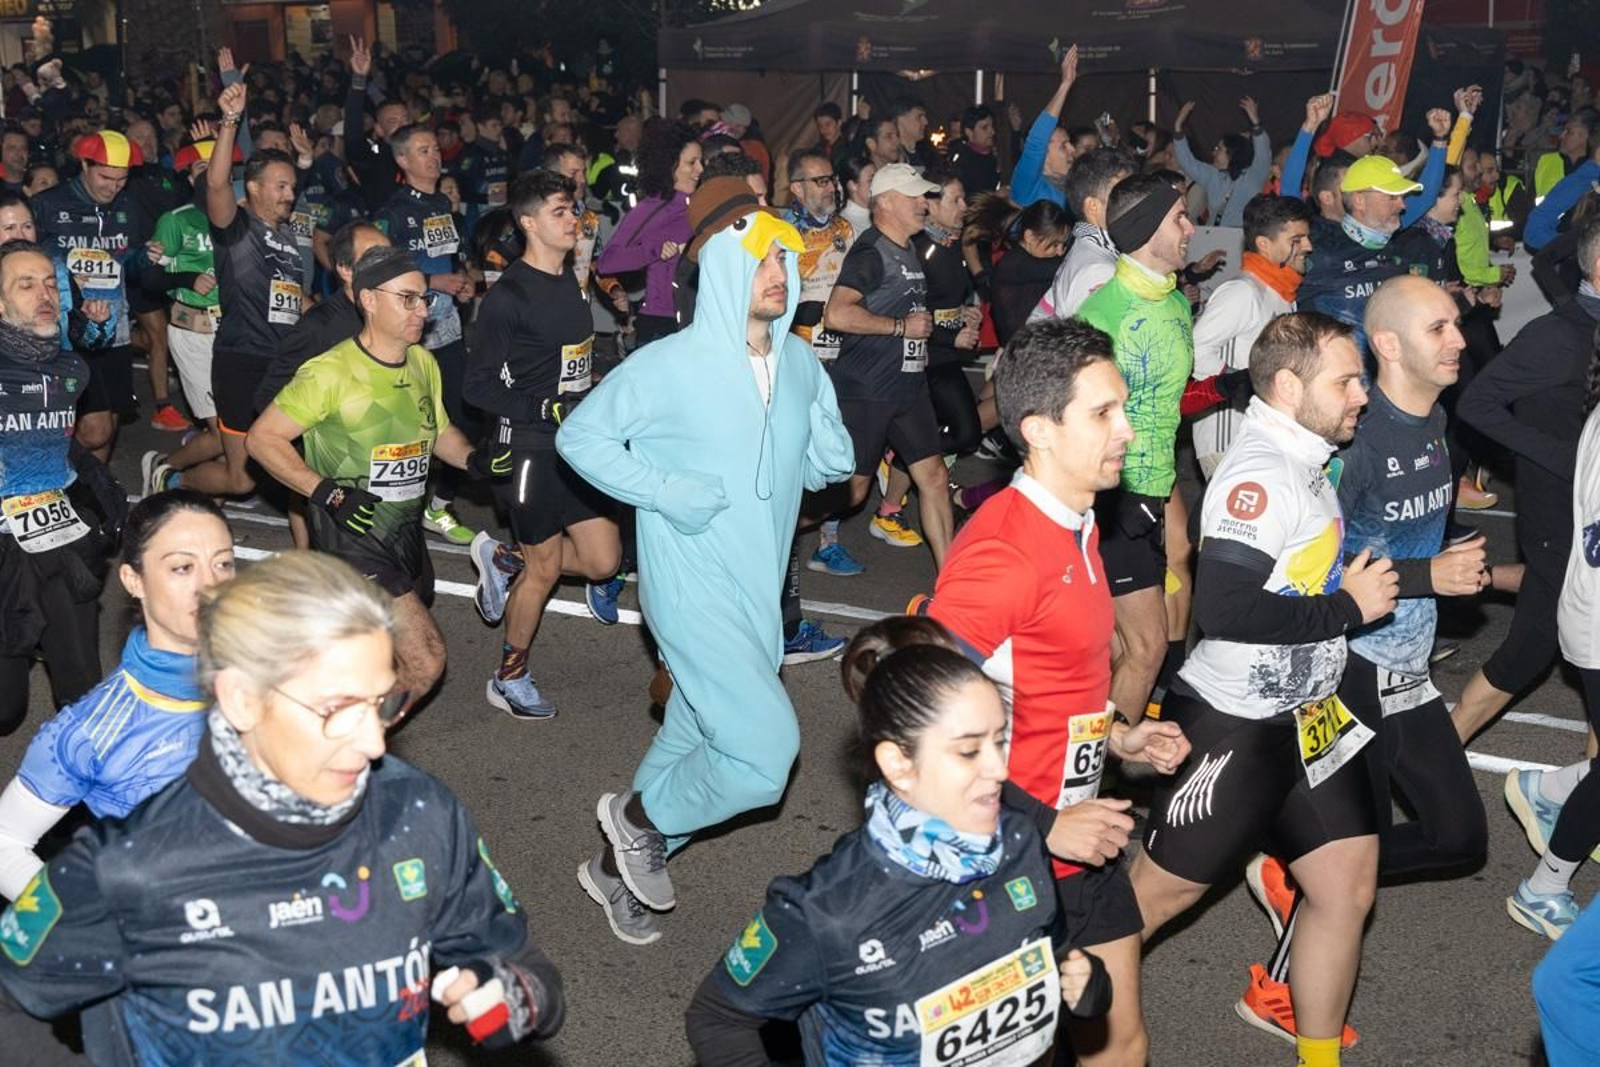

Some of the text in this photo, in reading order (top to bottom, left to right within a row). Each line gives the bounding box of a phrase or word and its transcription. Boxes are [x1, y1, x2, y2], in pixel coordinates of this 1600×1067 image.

[57, 235, 86, 249] SAN
[409, 238, 427, 251] SA
[72, 259, 114, 274] 4811
[36, 405, 76, 429] ANTÓ
[373, 456, 427, 479] 7496
[1383, 480, 1453, 522] SAN ANT
[14, 500, 71, 533] 7056
[1220, 518, 1257, 533] moreno
[1216, 524, 1257, 542] asesores
[1074, 739, 1106, 775] 65
[186, 979, 297, 1033] SAN
[949, 986, 976, 1012] 42
[864, 1002, 922, 1039] SA
[936, 980, 1046, 1063] 6425
